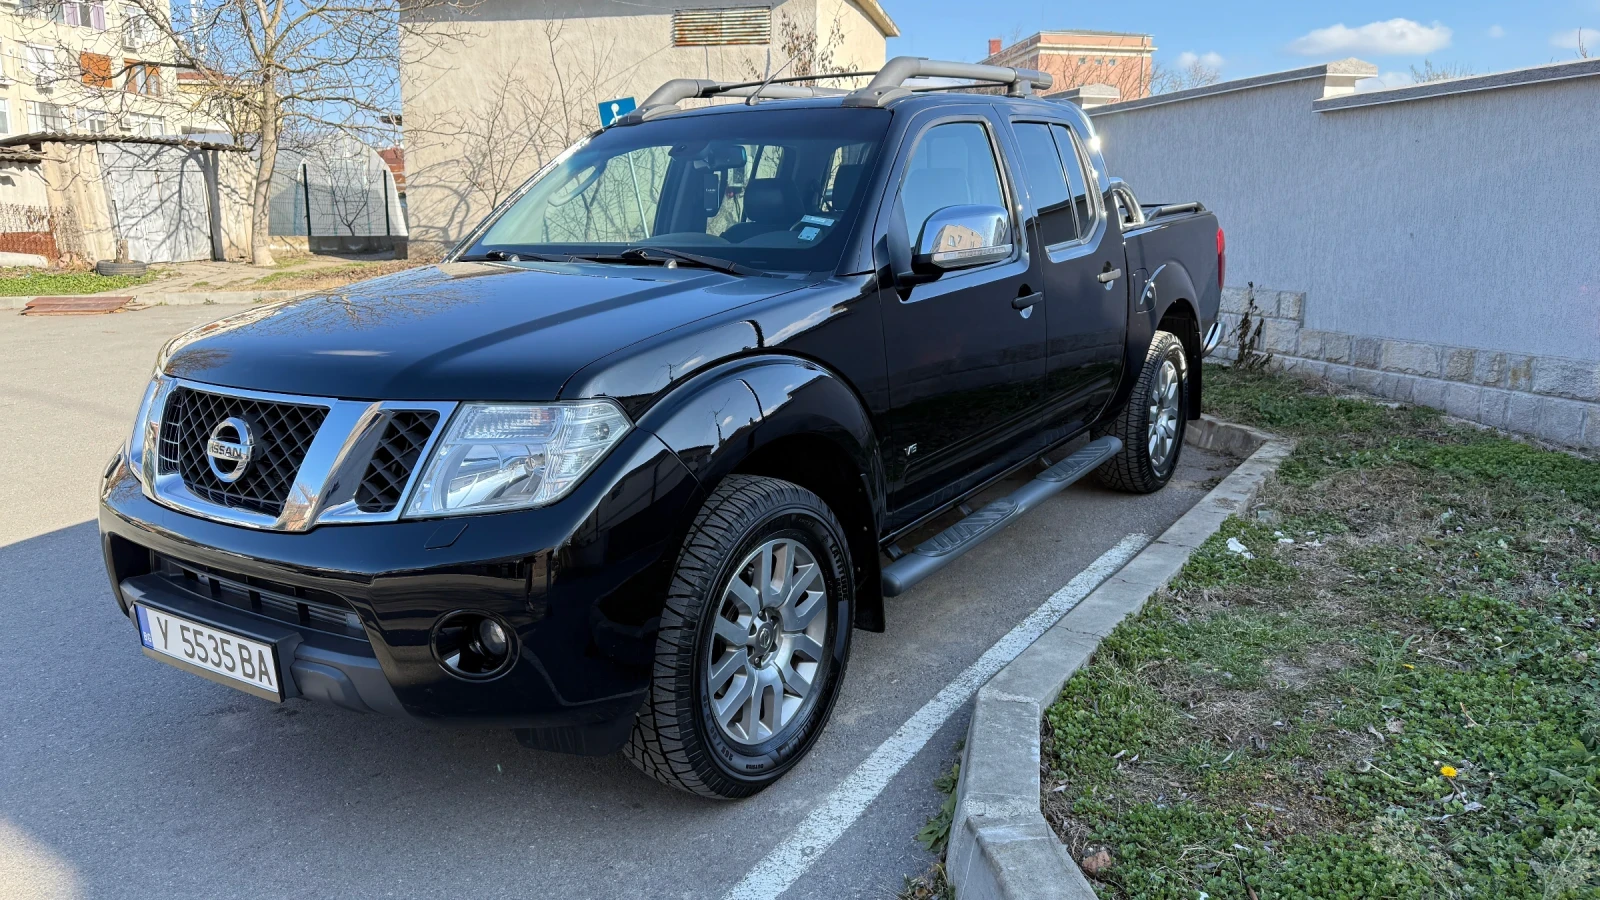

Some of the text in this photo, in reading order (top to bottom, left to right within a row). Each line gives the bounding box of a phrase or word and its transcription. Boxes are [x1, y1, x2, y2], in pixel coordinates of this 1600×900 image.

[829, 543, 847, 601] LATITUDE
[142, 631, 152, 642] BG
[156, 616, 168, 650] Y
